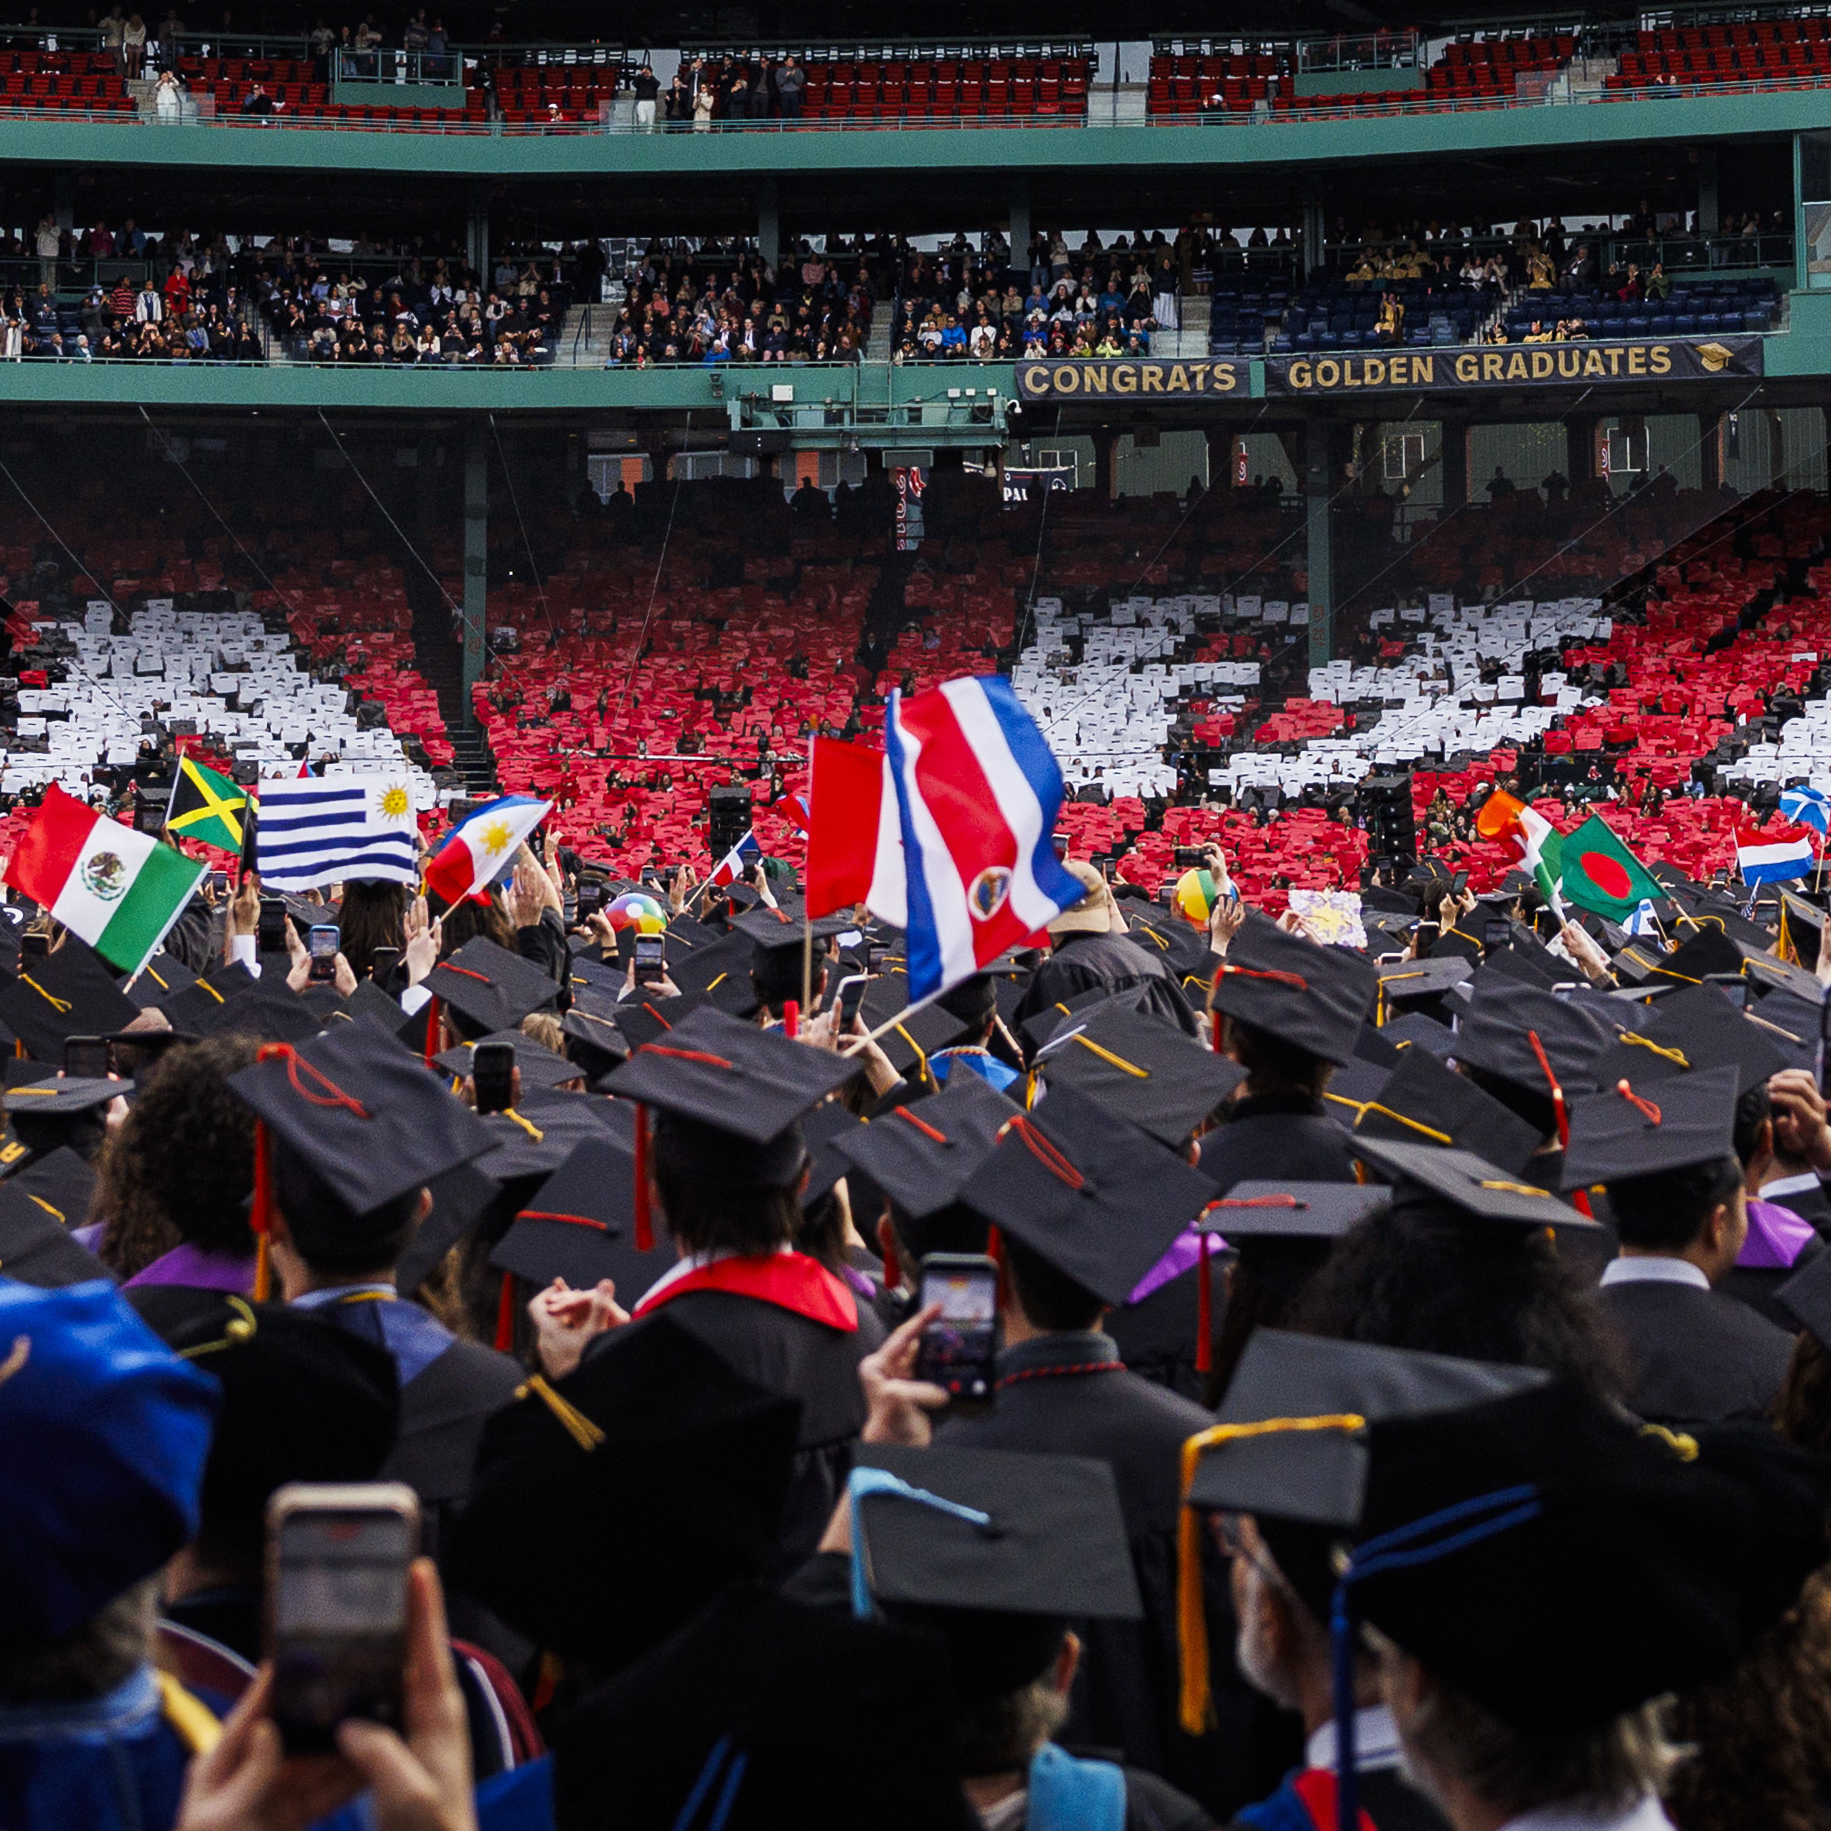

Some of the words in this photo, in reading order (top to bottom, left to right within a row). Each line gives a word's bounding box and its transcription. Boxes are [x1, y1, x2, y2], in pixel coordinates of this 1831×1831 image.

[1028, 363, 1236, 393] CONGRATS
[1289, 356, 1433, 388] GOLDEN
[1456, 344, 1672, 382] GRADUATES
